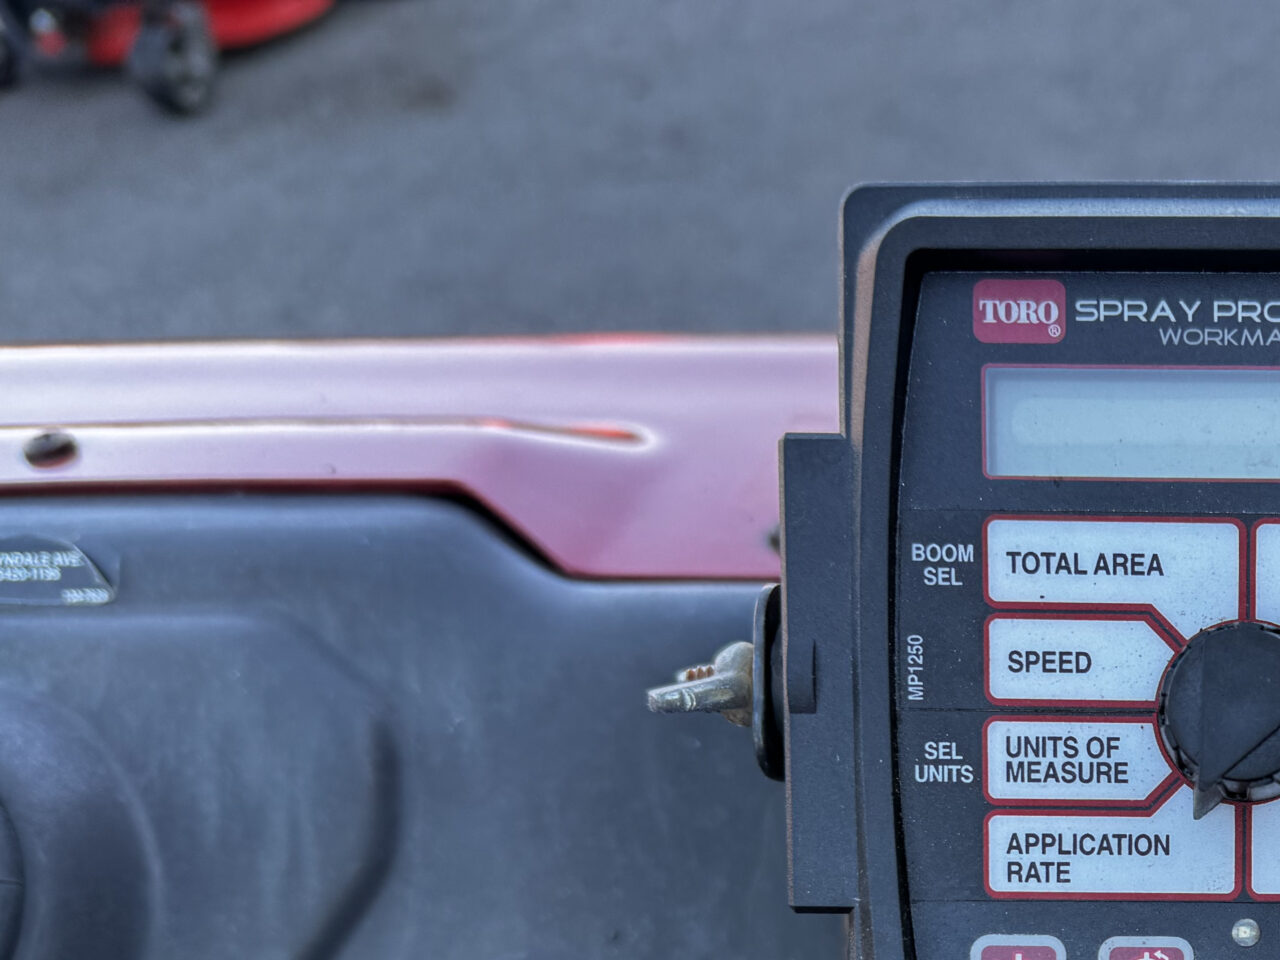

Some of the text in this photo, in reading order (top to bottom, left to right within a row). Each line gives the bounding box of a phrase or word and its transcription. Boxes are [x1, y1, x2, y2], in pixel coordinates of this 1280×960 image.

[1075, 299, 1201, 322] SPRAY
[911, 543, 974, 563] BOOM
[1006, 551, 1165, 576] TOTAL AREA
[923, 567, 963, 586] SEL
[907, 634, 924, 700] MP1250
[1007, 650, 1092, 674] SPEED
[924, 742, 963, 760] SEL
[1006, 736, 1121, 758] UNITS OF
[914, 765, 974, 783] UNITS
[1005, 761, 1129, 784] MEASURE
[1006, 833, 1171, 856] APPLICATION
[1007, 861, 1071, 883] RATE
